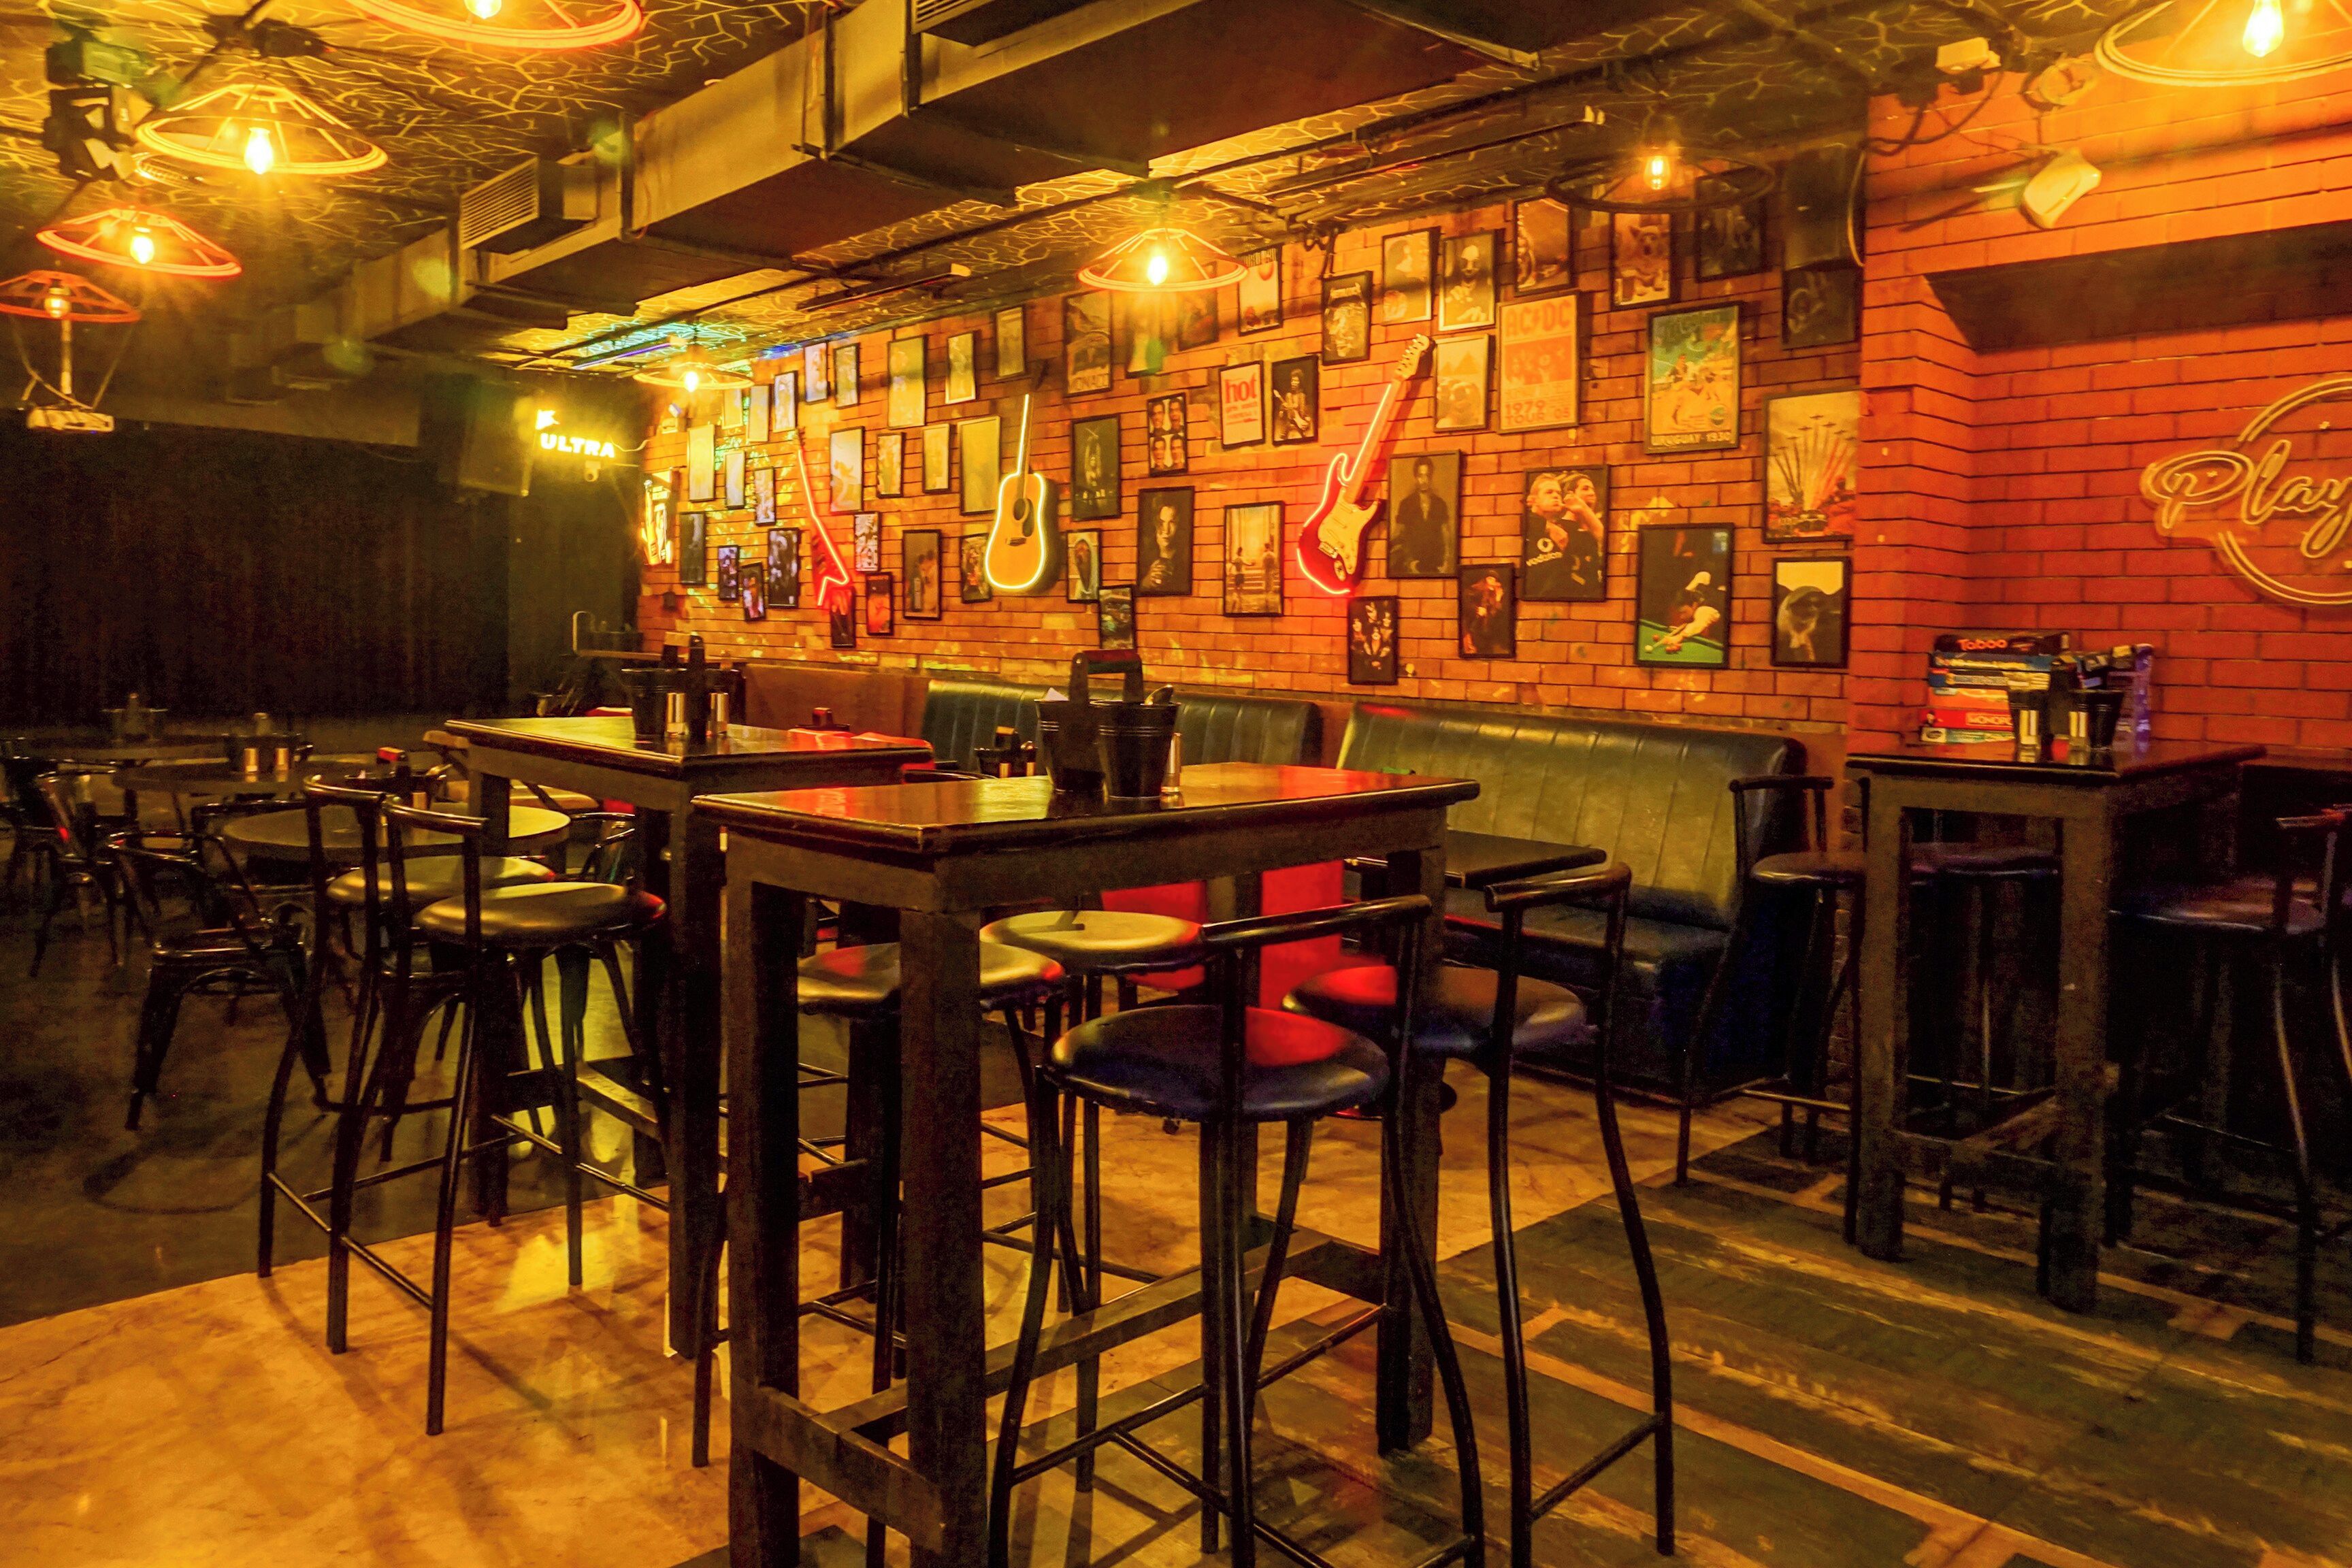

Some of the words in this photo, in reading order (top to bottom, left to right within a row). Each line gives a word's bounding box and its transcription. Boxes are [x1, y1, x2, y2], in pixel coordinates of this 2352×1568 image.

[1225, 373, 1258, 404] hot
[540, 432, 615, 459] ULTRA
[1957, 638, 2009, 651] Taboo
